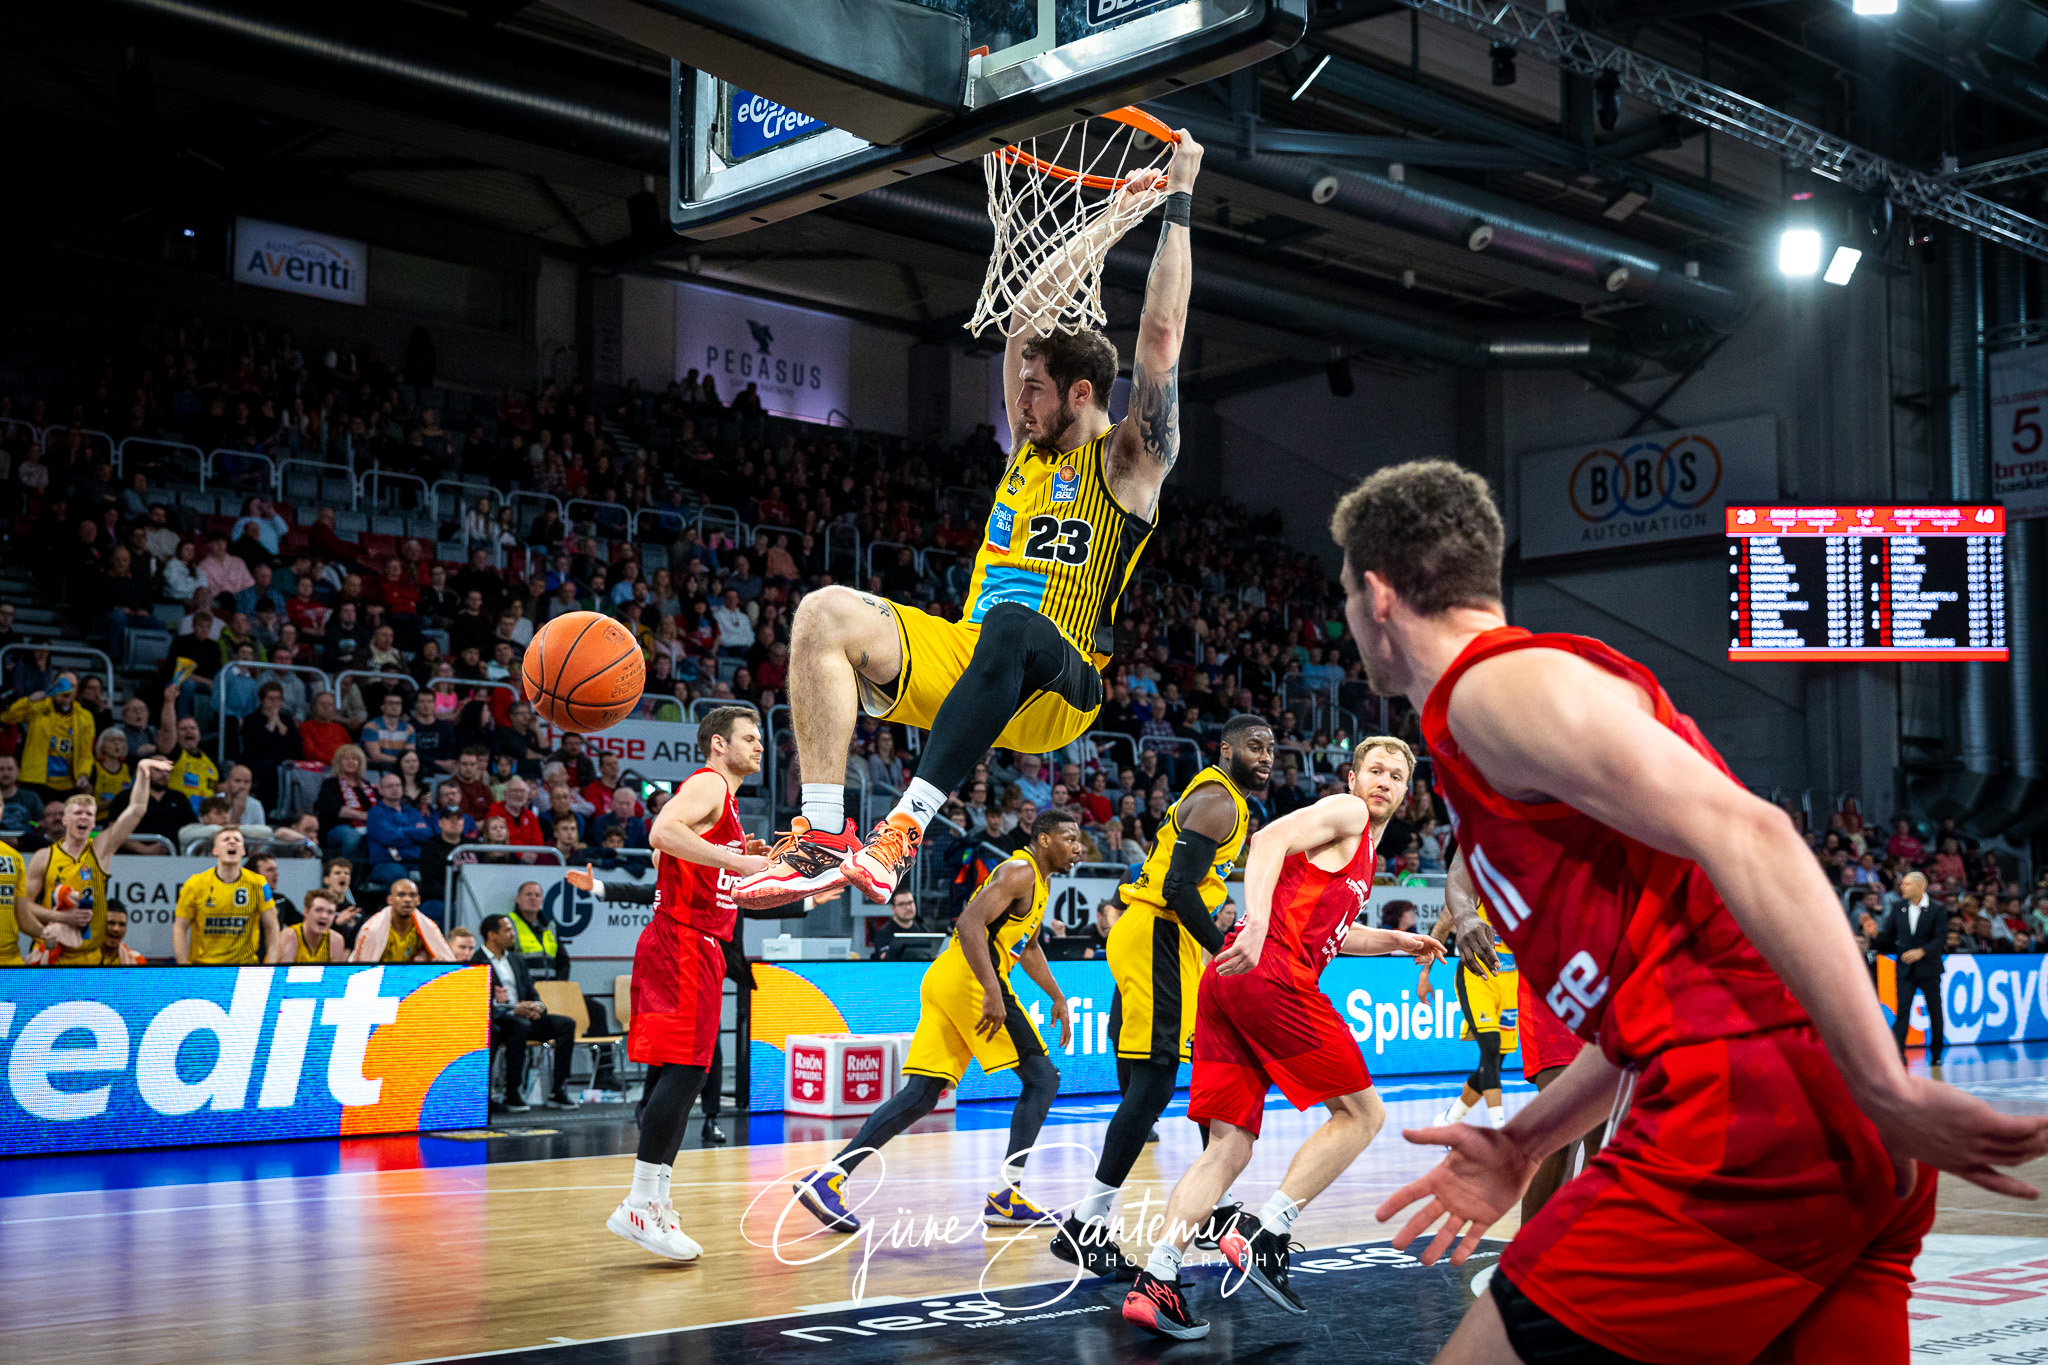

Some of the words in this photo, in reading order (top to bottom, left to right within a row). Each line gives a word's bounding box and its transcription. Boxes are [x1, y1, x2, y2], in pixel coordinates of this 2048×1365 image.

[706, 345, 822, 390] PEGASUS
[2011, 406, 2043, 456] 5
[1591, 451, 1697, 506] BBS
[1994, 460, 2048, 479] bros
[1055, 491, 1073, 499] BBL
[1975, 508, 1995, 523] 40
[1581, 513, 1707, 542] AUTOMATION
[1023, 514, 1093, 566] 23
[653, 740, 706, 763] ARE
[234, 888, 247, 906] 6
[1347, 988, 1466, 1055] Spielr
[795, 1052, 822, 1070] RHÖN
[847, 1054, 879, 1071] RHÖN
[795, 1070, 822, 1081] SPRUDEL
[846, 1070, 879, 1081] SPRUDEL
[968, 1304, 1110, 1329] Magnequench
